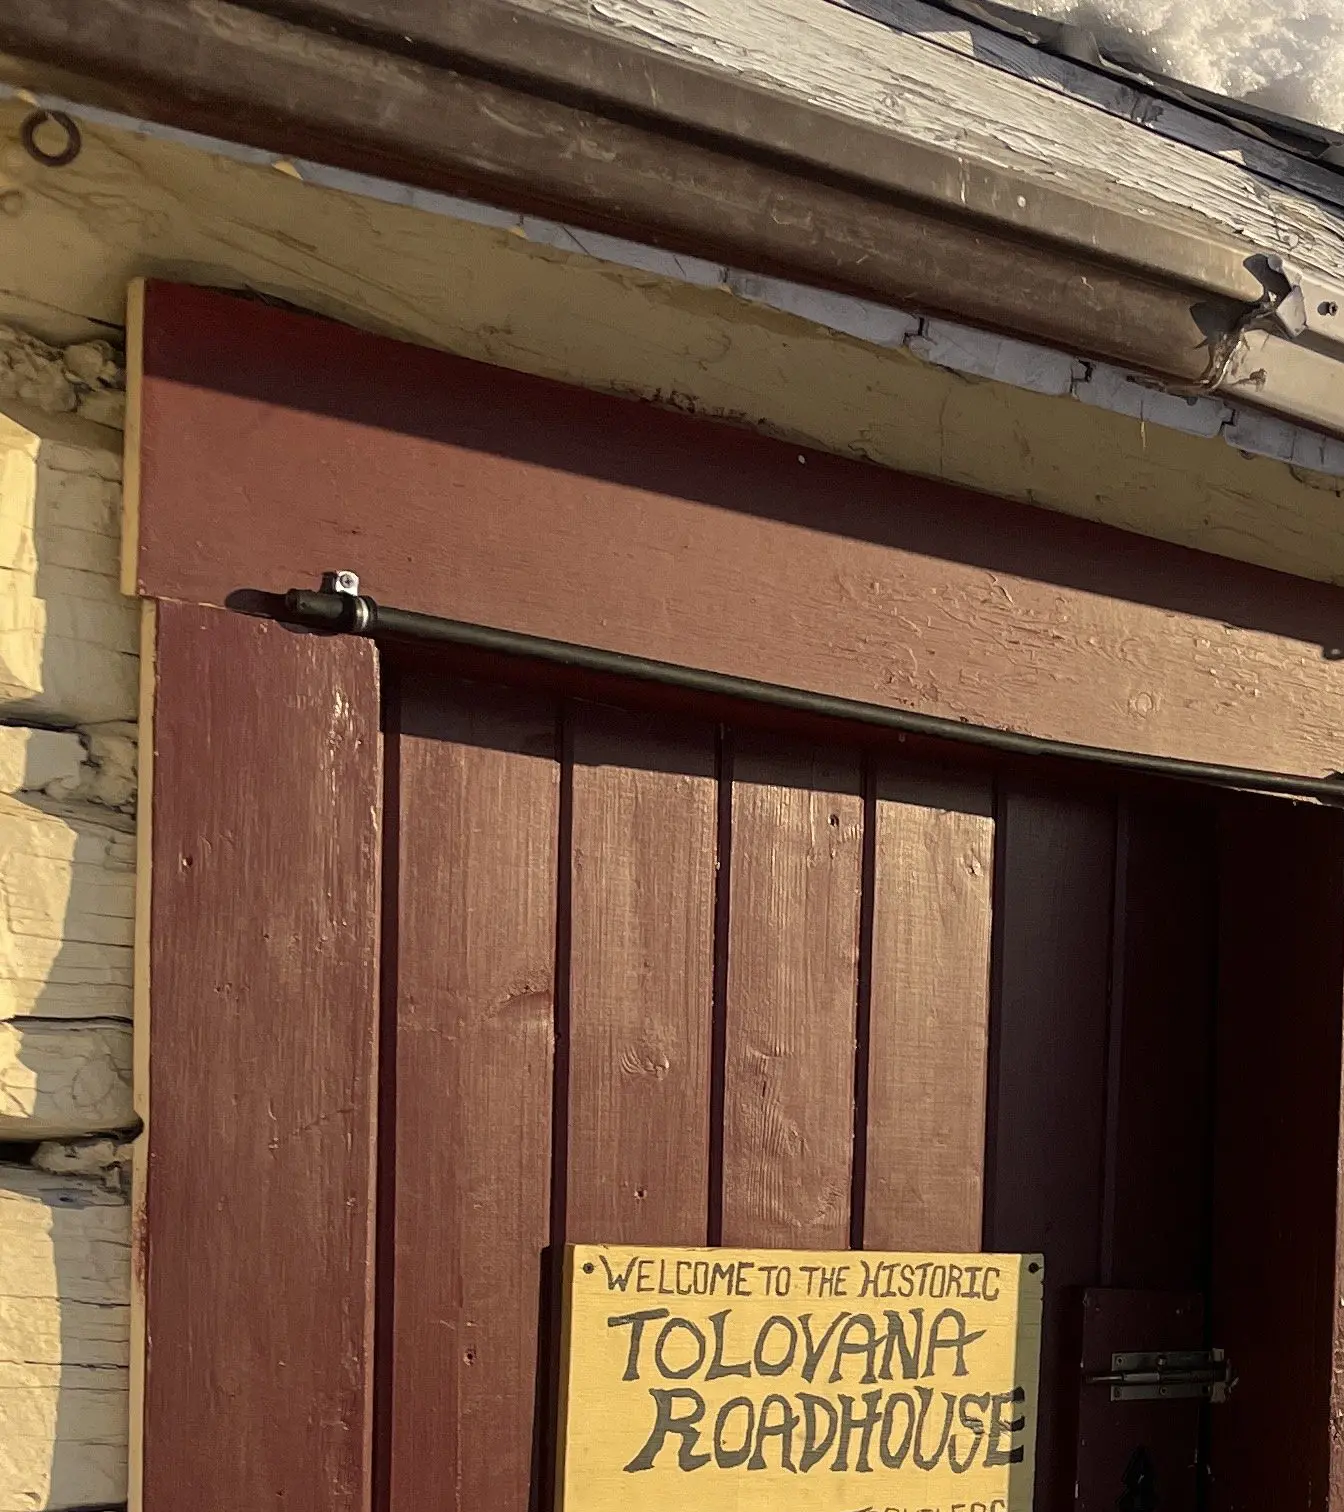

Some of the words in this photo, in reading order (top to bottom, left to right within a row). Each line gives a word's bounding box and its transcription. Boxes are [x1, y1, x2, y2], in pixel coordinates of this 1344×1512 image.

[599, 1255, 754, 1297] WELCOME
[760, 1265, 791, 1296] TO
[801, 1265, 850, 1297] THE
[858, 1260, 1000, 1300] HISTORIC
[607, 1307, 987, 1384] TOLOVANA
[622, 1385, 1025, 1473] ROADHOUSE
